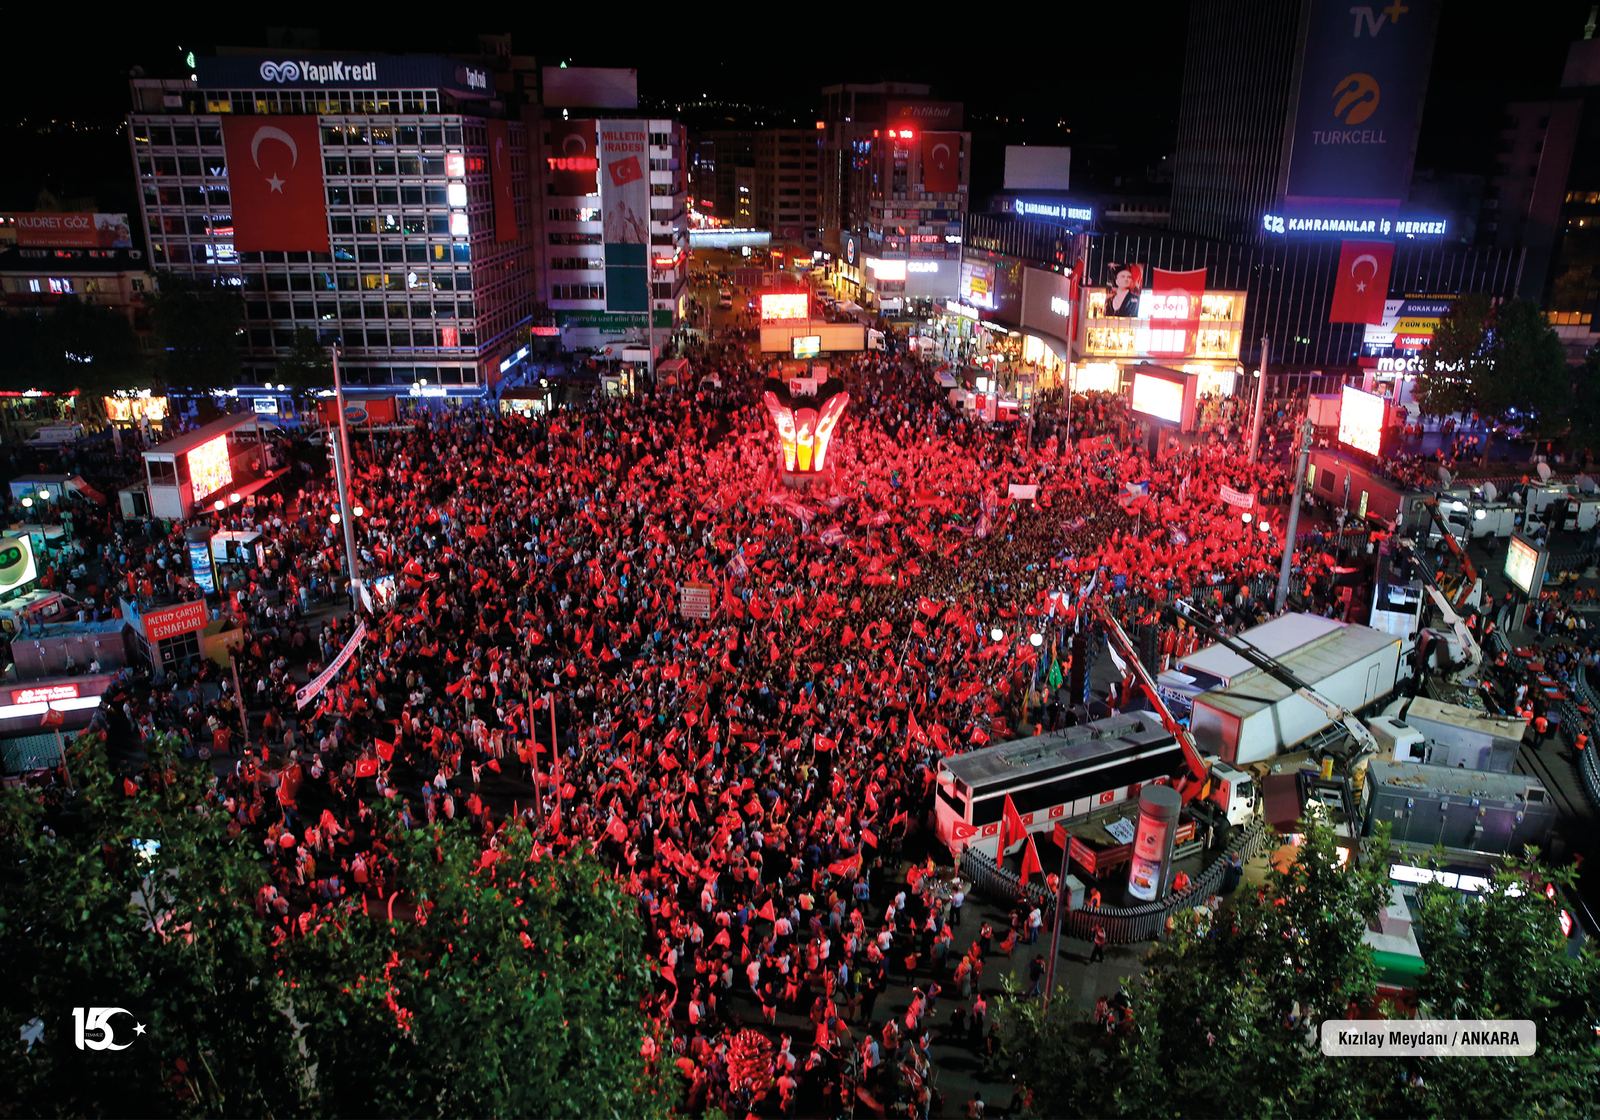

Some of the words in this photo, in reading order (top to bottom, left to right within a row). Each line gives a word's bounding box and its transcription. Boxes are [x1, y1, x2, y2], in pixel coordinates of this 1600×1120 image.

[299, 61, 377, 84] YapıKredi
[1312, 130, 1387, 145] TURKCELL
[17, 216, 62, 229] KUDRET
[63, 215, 90, 229] GÖZ
[1288, 218, 1376, 232] KAHRAMANLAR
[1379, 217, 1391, 235] İŞ
[1395, 219, 1447, 234] MERKEZİ
[1405, 320, 1421, 328] GÜN
[148, 612, 175, 626] METRO
[175, 604, 203, 620] ÇARŞISI
[153, 616, 201, 638] ESNAFLARI
